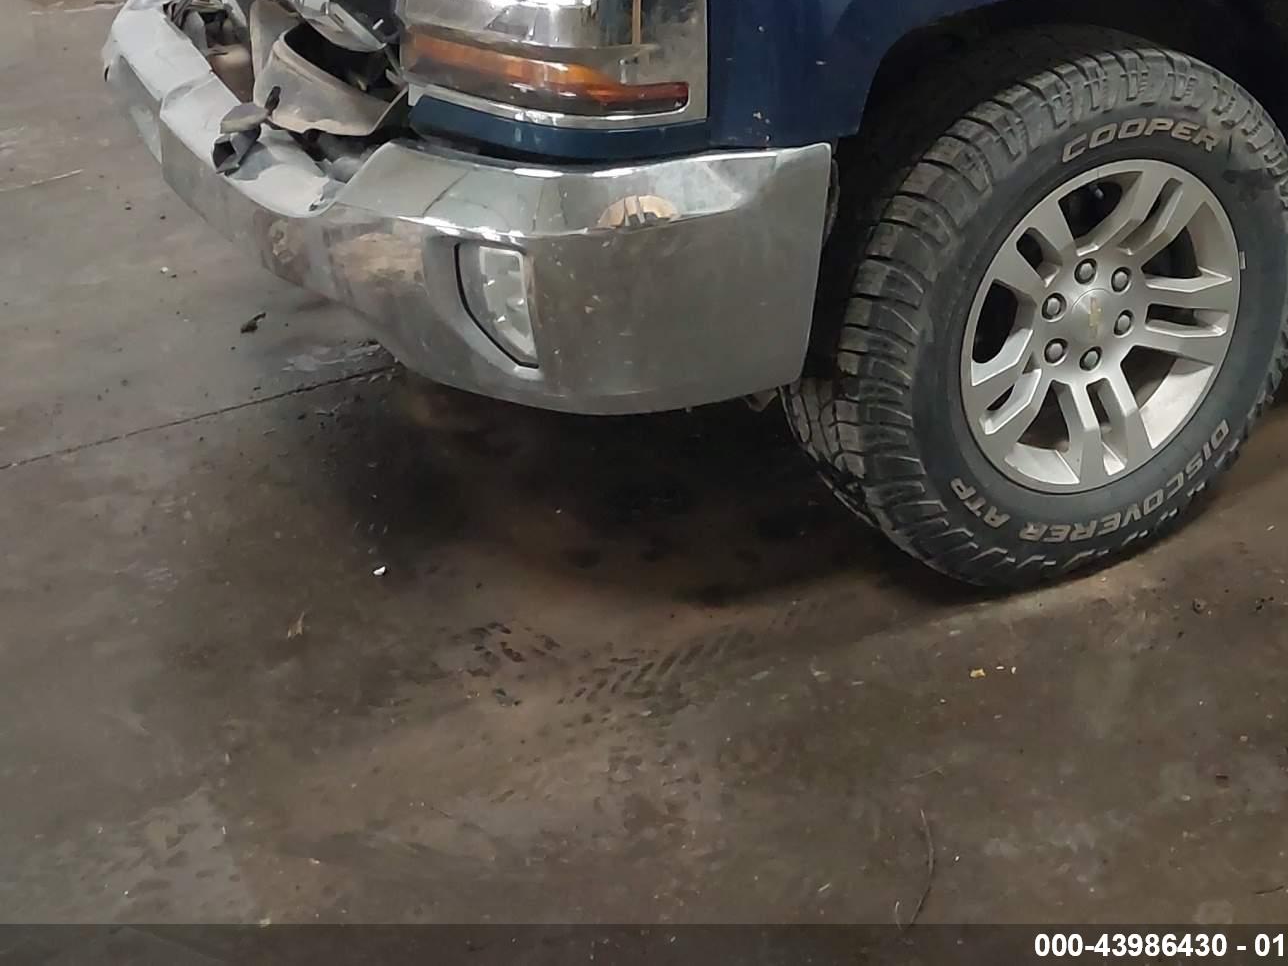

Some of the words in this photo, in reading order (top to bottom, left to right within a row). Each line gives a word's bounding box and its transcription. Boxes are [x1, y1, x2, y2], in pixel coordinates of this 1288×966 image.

[1062, 118, 1222, 163] COOPER
[950, 477, 1011, 528] ATP
[1018, 419, 1231, 543] DISCOVERER
